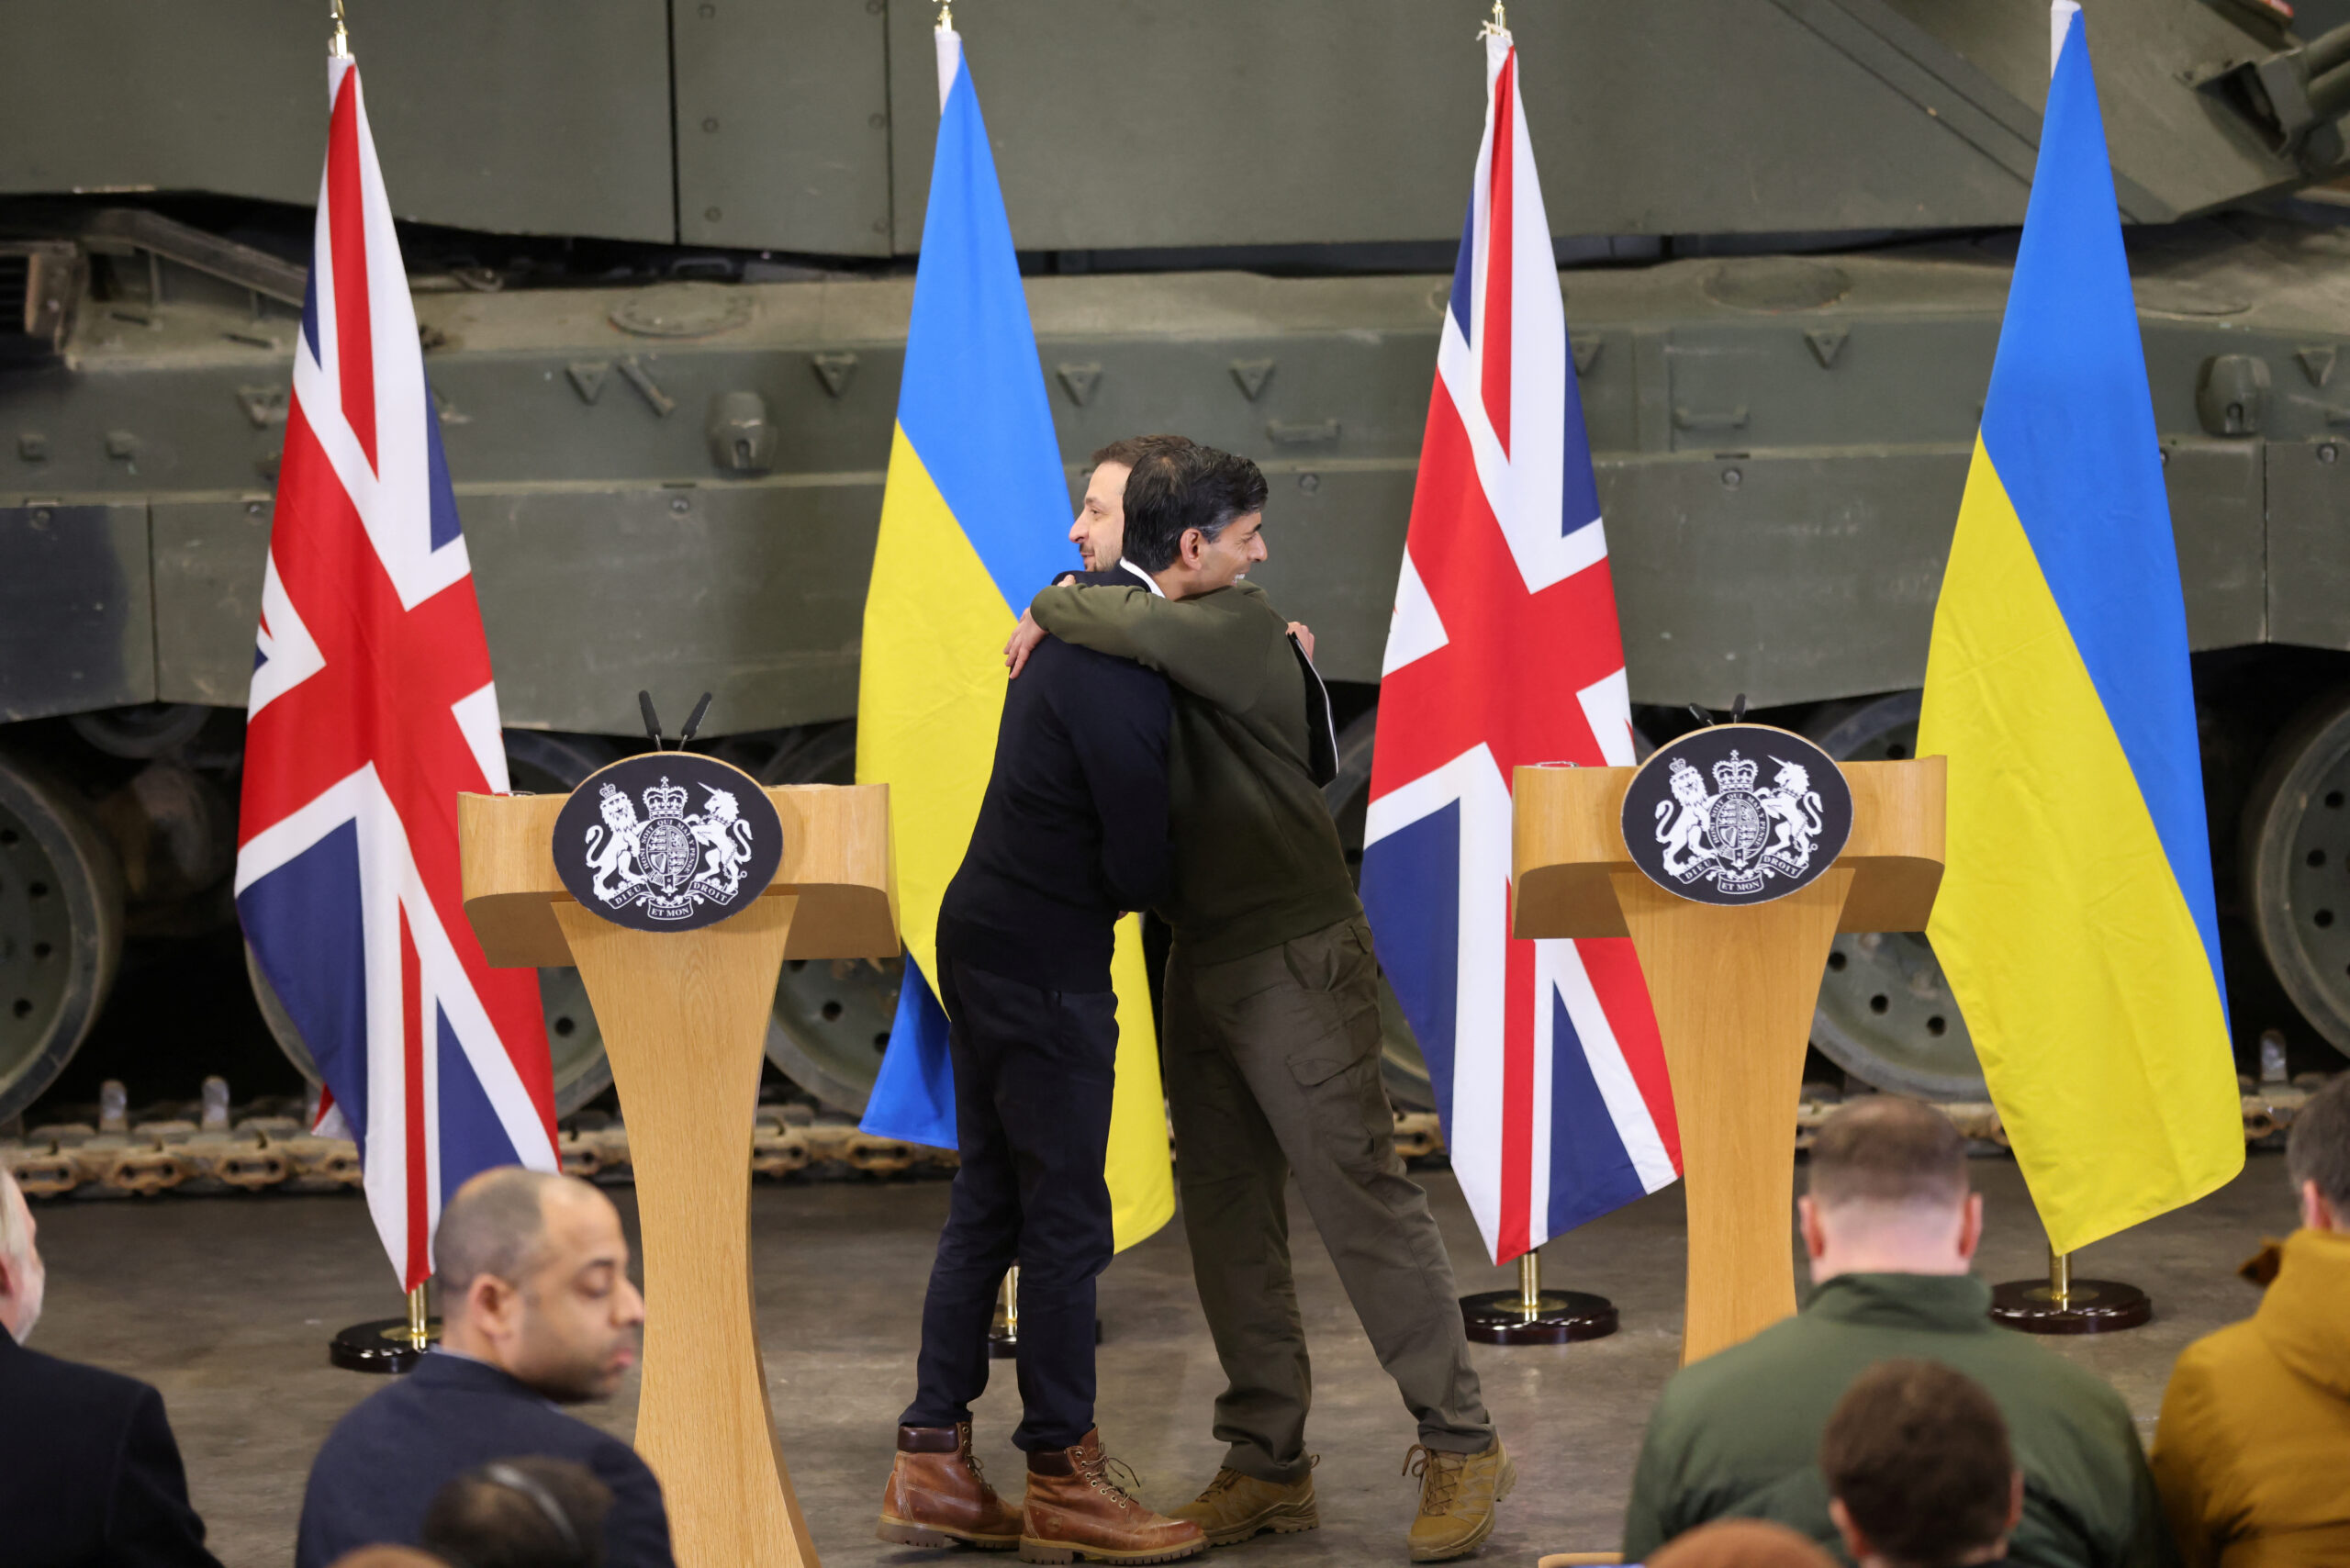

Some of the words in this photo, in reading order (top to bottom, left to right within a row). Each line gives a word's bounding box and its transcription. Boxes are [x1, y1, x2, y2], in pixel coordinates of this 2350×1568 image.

[641, 825, 655, 845] SOIT
[677, 823, 691, 839] MAL
[640, 847, 650, 869] HONI
[1684, 859, 1712, 879] DIEU
[1721, 882, 1734, 890] ET
[1736, 880, 1760, 890] MON
[1762, 856, 1798, 875] DROIT
[614, 885, 642, 905] DIEU
[651, 908, 664, 917] ET
[666, 907, 689, 917] MON
[693, 882, 728, 902] DROIT
